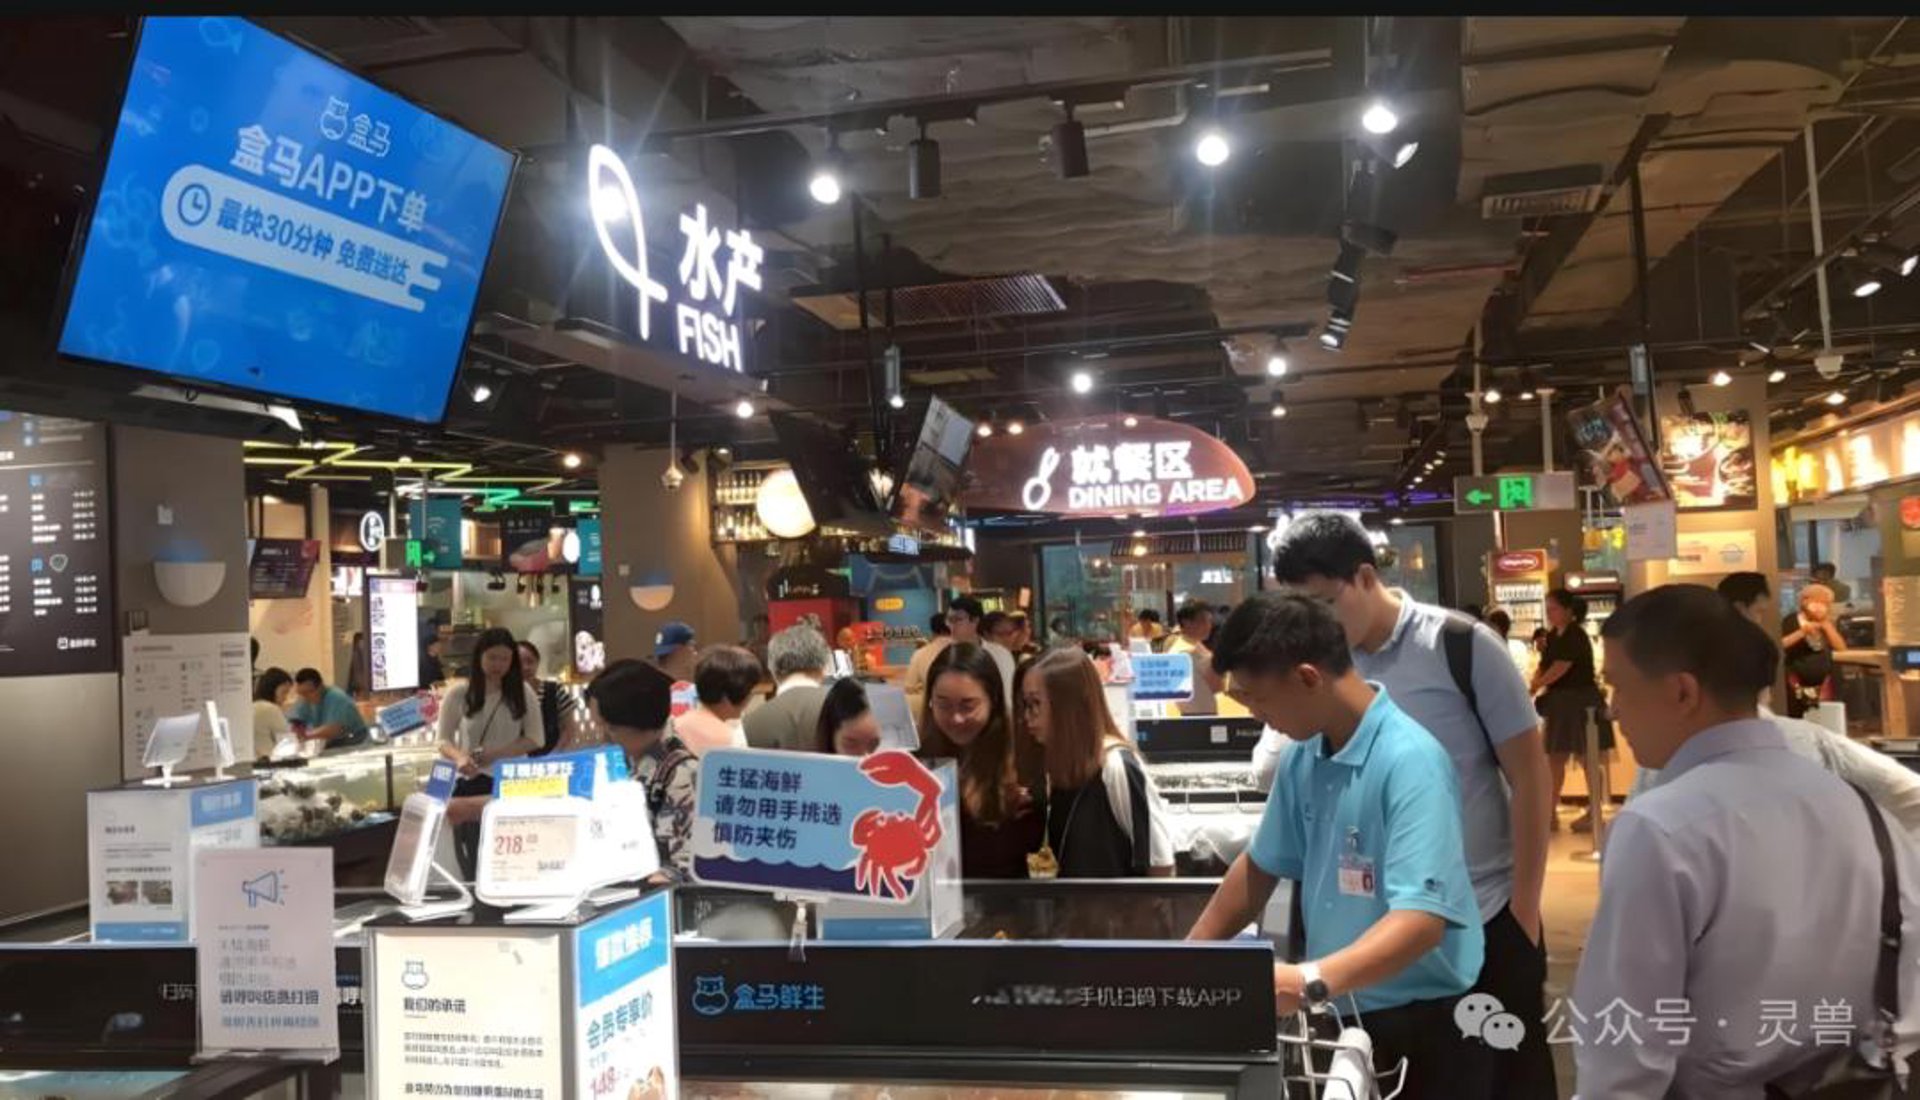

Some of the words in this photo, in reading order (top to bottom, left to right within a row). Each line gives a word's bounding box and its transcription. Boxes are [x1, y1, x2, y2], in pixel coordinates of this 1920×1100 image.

[347, 113, 391, 157] 盒马
[230, 124, 427, 233] 盒马APP下单
[217, 198, 335, 260] 最快30分钟
[335, 240, 411, 285] 免费送达
[679, 203, 763, 316] 水产
[677, 303, 743, 373] FISH
[1071, 441, 1193, 484] 就餐区
[1069, 482, 1162, 509] DINING
[1168, 477, 1245, 504] AREA
[717, 766, 802, 793] 生猛海鲜
[715, 794, 842, 826] 请勿用手挑选
[713, 822, 797, 849] 慎防夹伤
[733, 982, 825, 1010] 盒马鲜生
